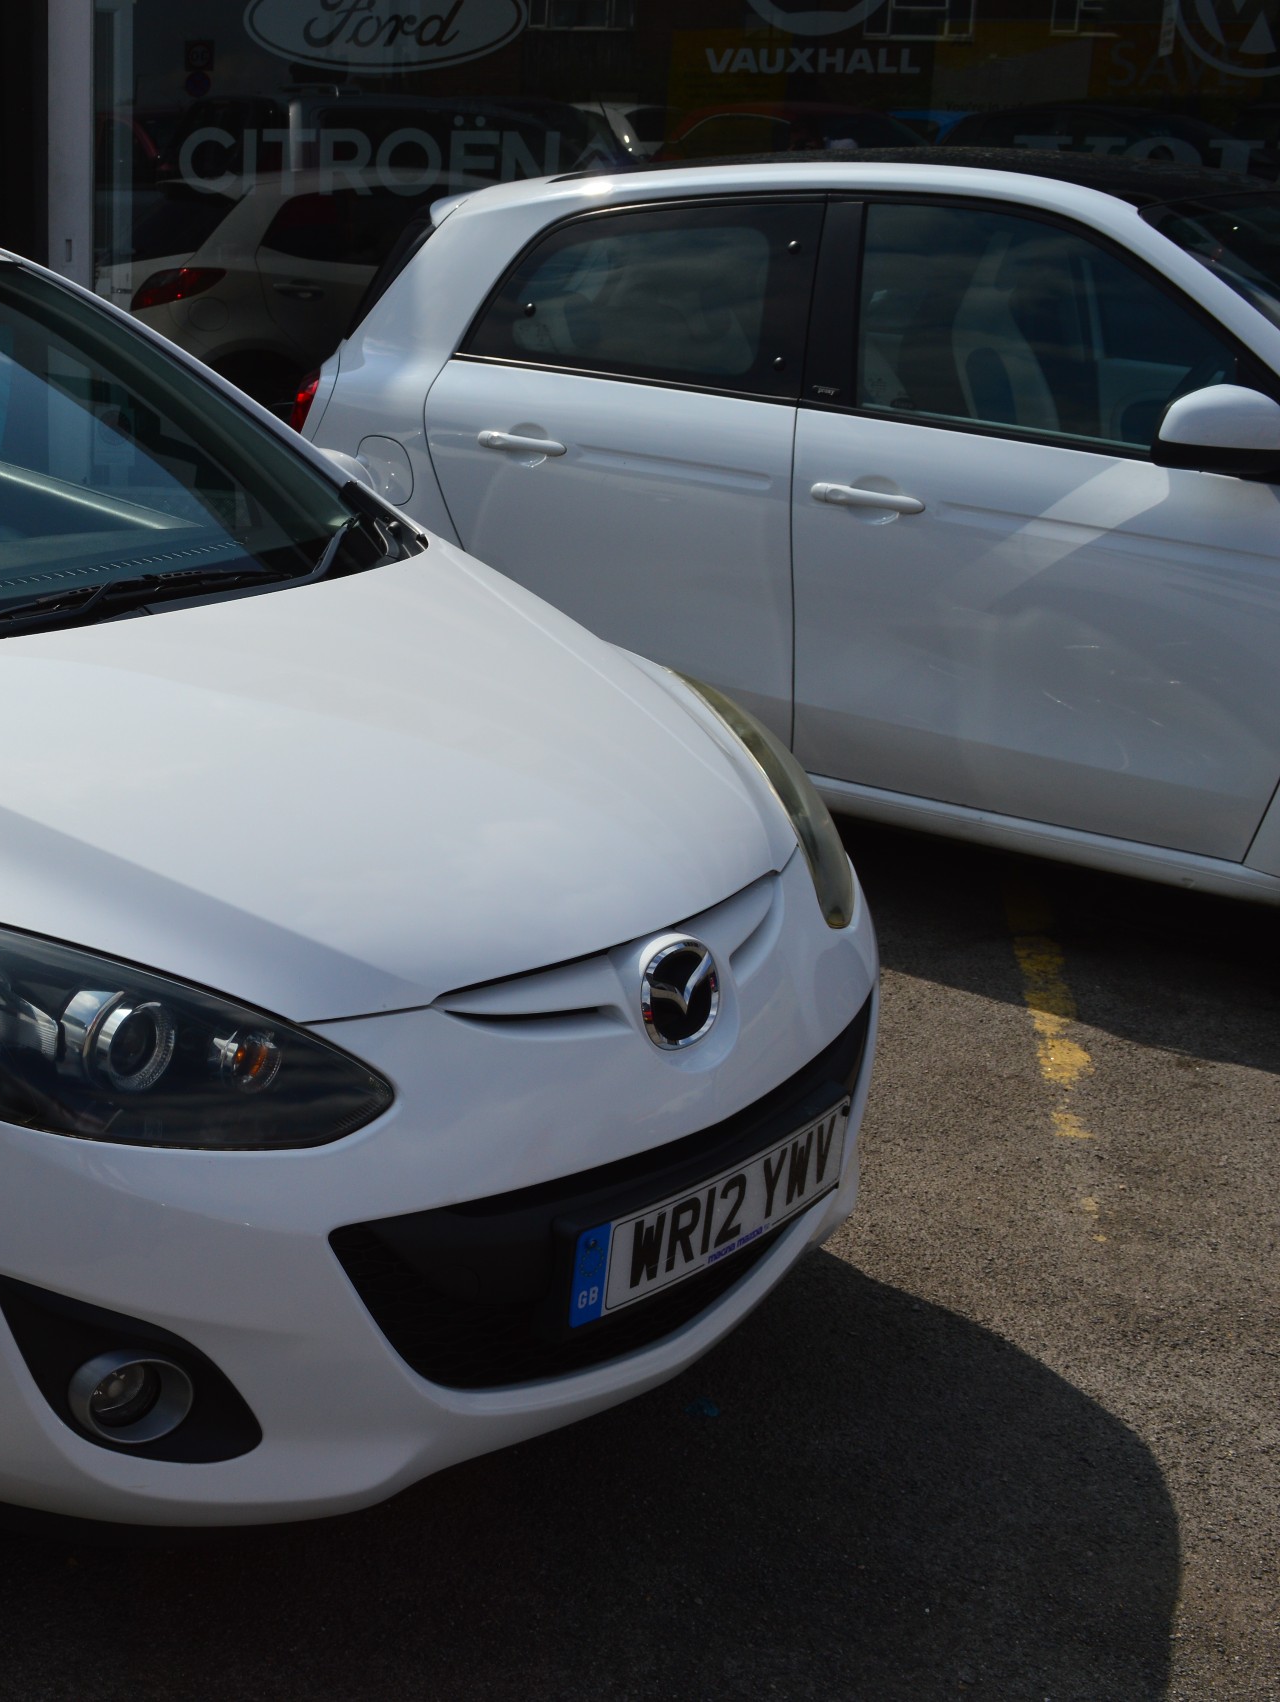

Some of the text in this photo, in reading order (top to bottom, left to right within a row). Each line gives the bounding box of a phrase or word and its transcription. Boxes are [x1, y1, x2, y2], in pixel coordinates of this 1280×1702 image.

[302, 0, 458, 48] Ford
[705, 47, 920, 74] VAUXHALL
[178, 115, 561, 196] CITROËN
[629, 1113, 838, 1289] WR12 YWV
[577, 1285, 599, 1310] GB
